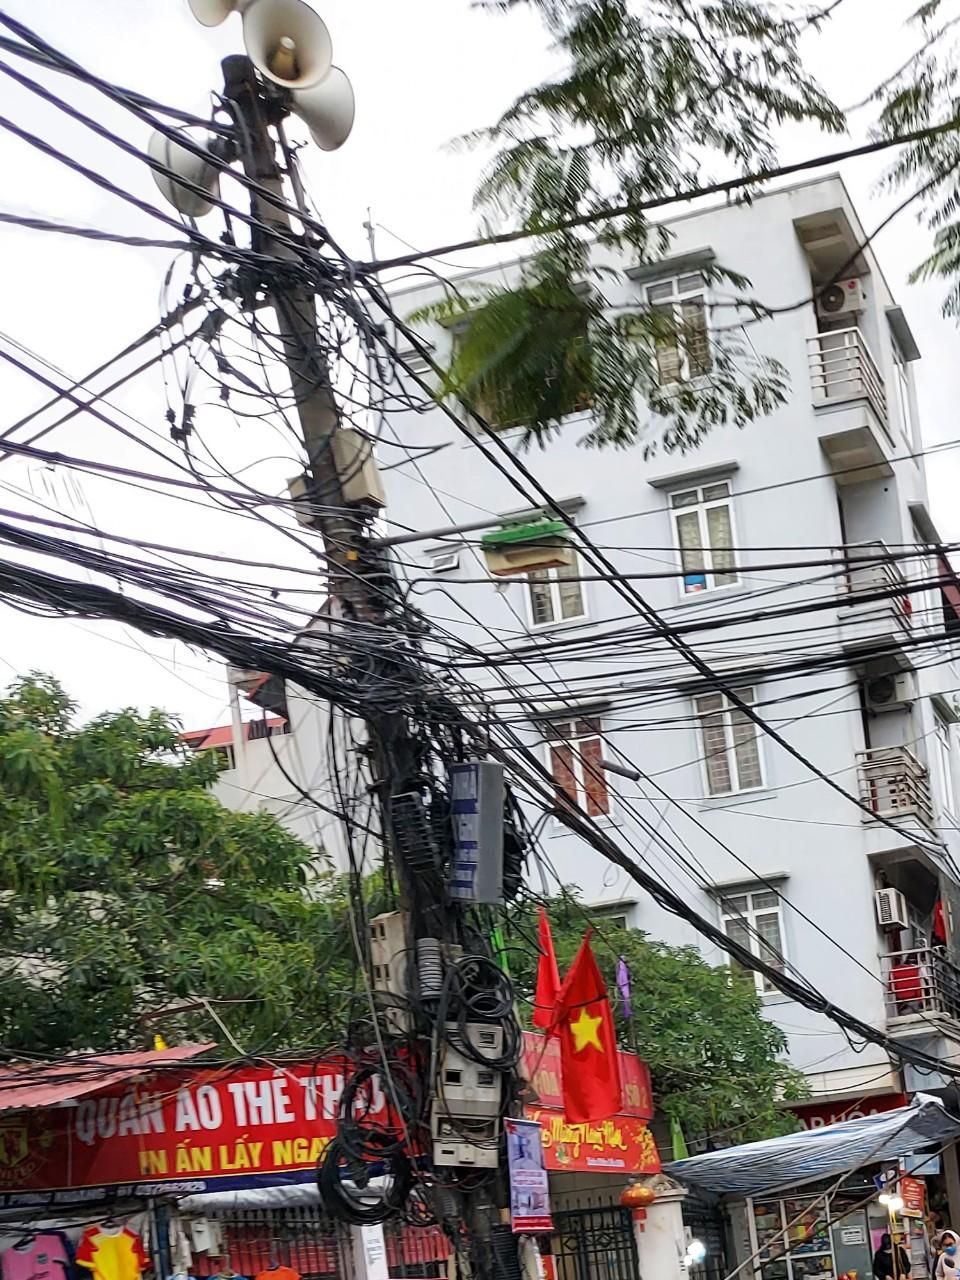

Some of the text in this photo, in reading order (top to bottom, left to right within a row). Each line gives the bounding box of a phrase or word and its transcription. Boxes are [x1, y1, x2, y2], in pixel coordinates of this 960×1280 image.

[138, 1150, 168, 1176] IN
[175, 1139, 213, 1174] ẤN
[219, 1134, 264, 1171] LẤY
